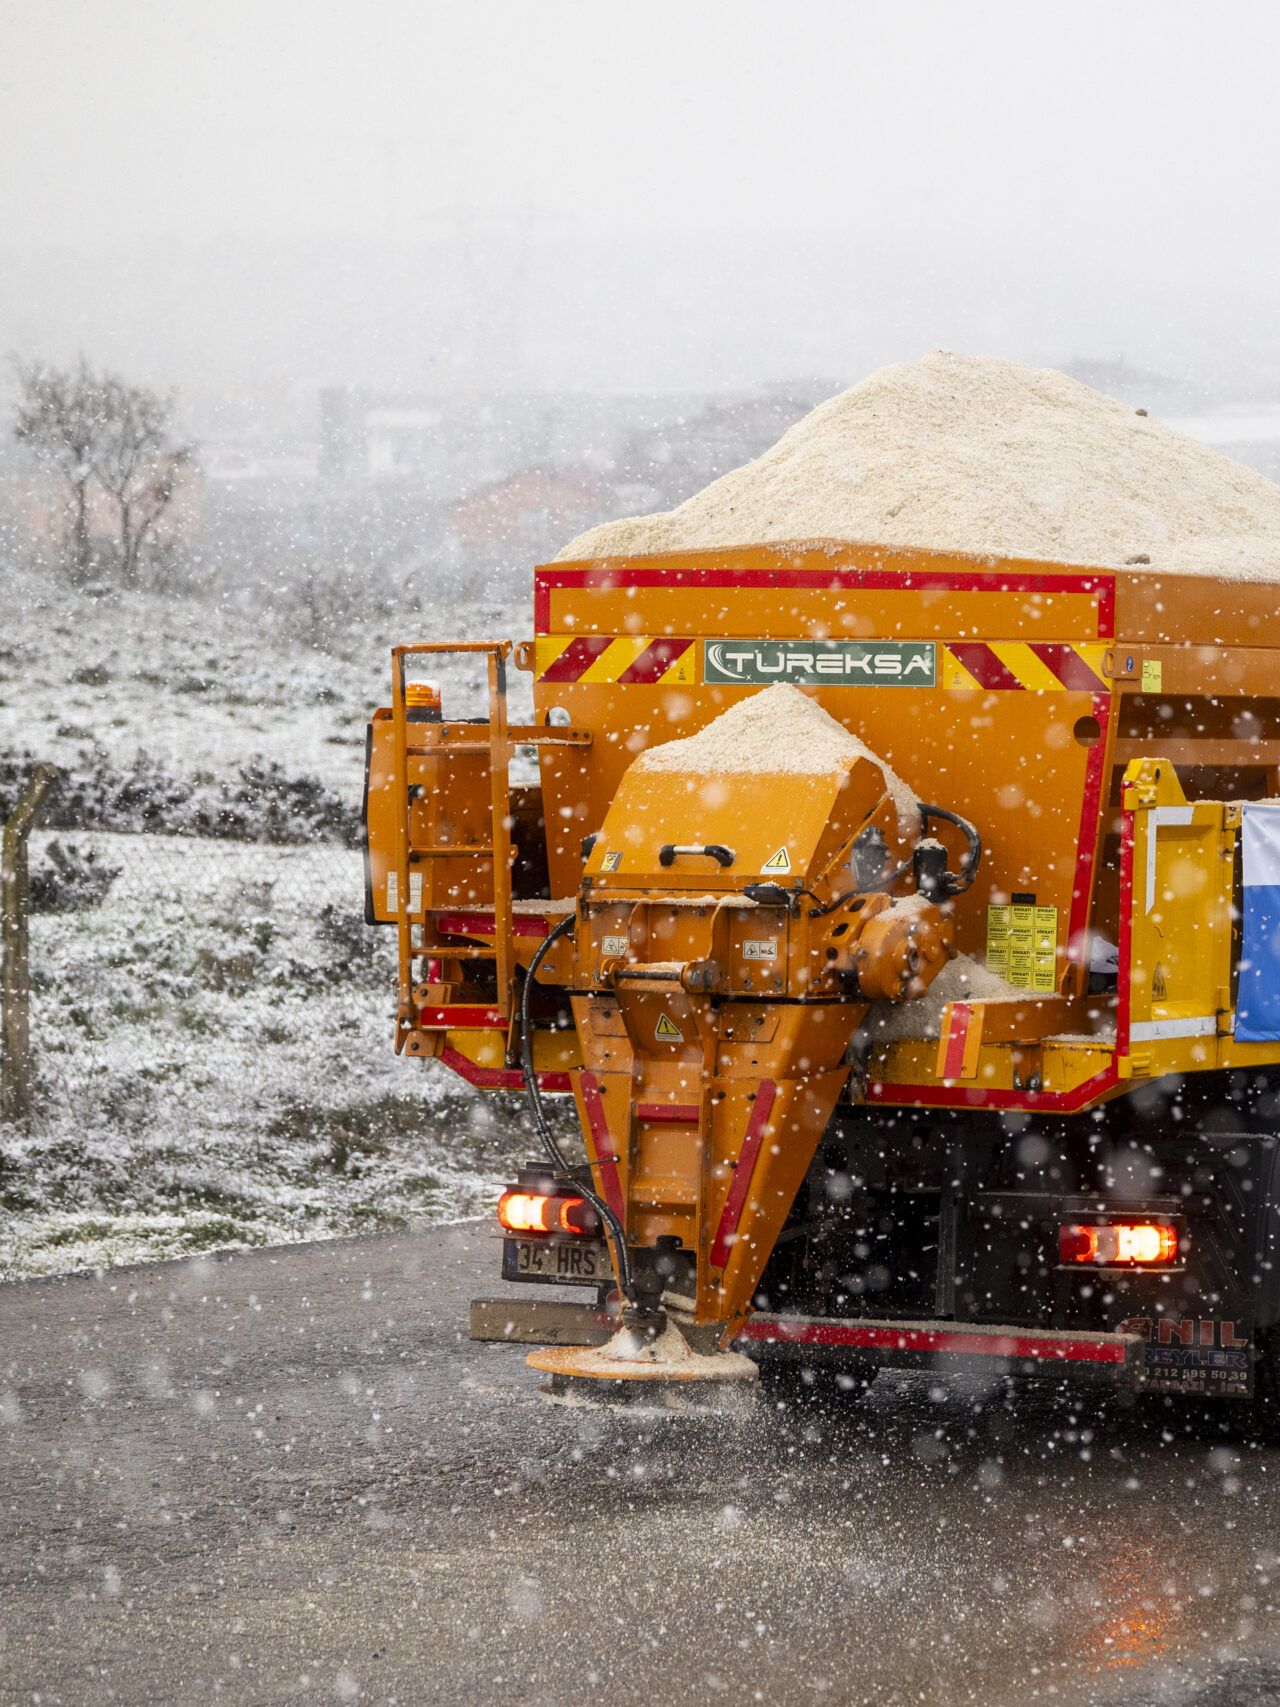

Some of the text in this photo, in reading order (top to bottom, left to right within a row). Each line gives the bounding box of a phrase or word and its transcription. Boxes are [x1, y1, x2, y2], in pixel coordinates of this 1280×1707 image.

[519, 1244, 595, 1275] 34 HRS
[1144, 1348, 1248, 1369] REYLER
[1154, 1368, 1178, 1377] 212
[1183, 1369, 1207, 1379] 595
[1211, 1370, 1227, 1379] 50
[1231, 1371, 1247, 1380] 39
